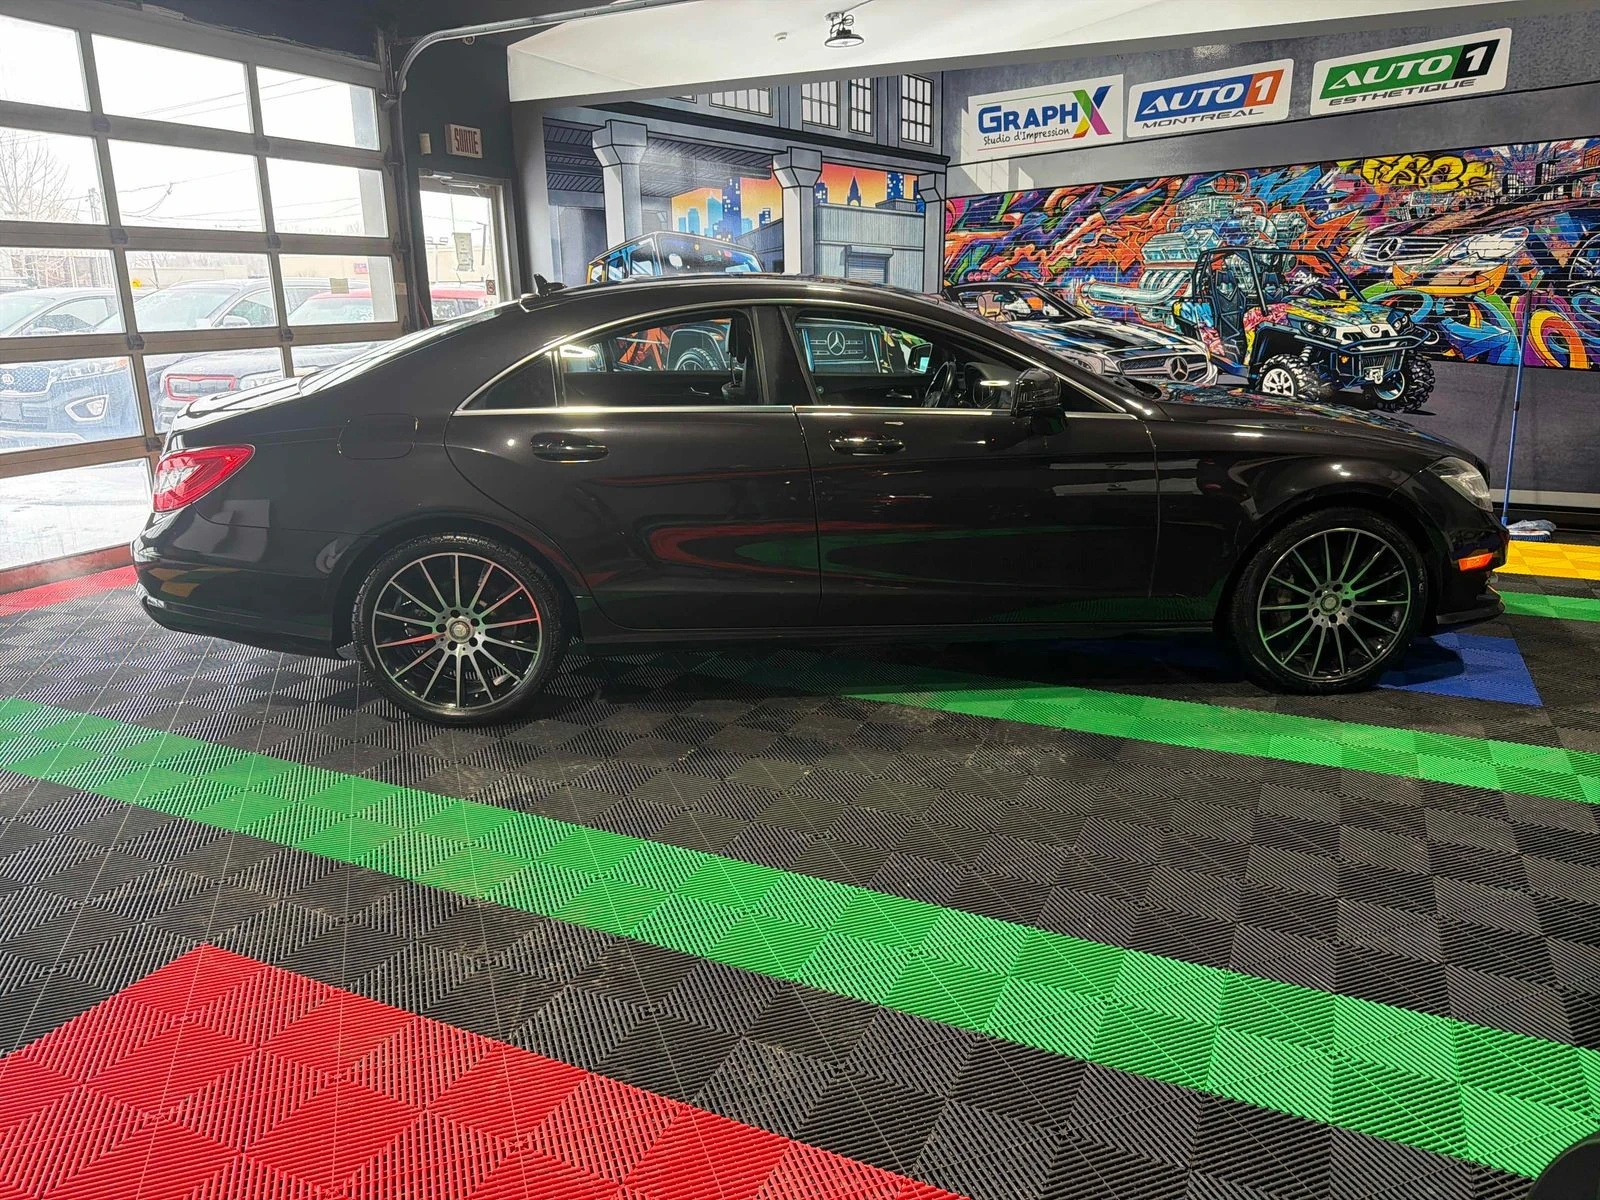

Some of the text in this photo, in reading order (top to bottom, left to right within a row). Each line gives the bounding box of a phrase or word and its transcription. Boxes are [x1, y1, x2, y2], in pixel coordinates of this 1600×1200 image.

[1328, 78, 1477, 107] ESTHETIQUE
[1142, 108, 1264, 129] MONTREAL
[454, 127, 479, 154] SORTIE
[983, 128, 1070, 145] Studio d'Impression
